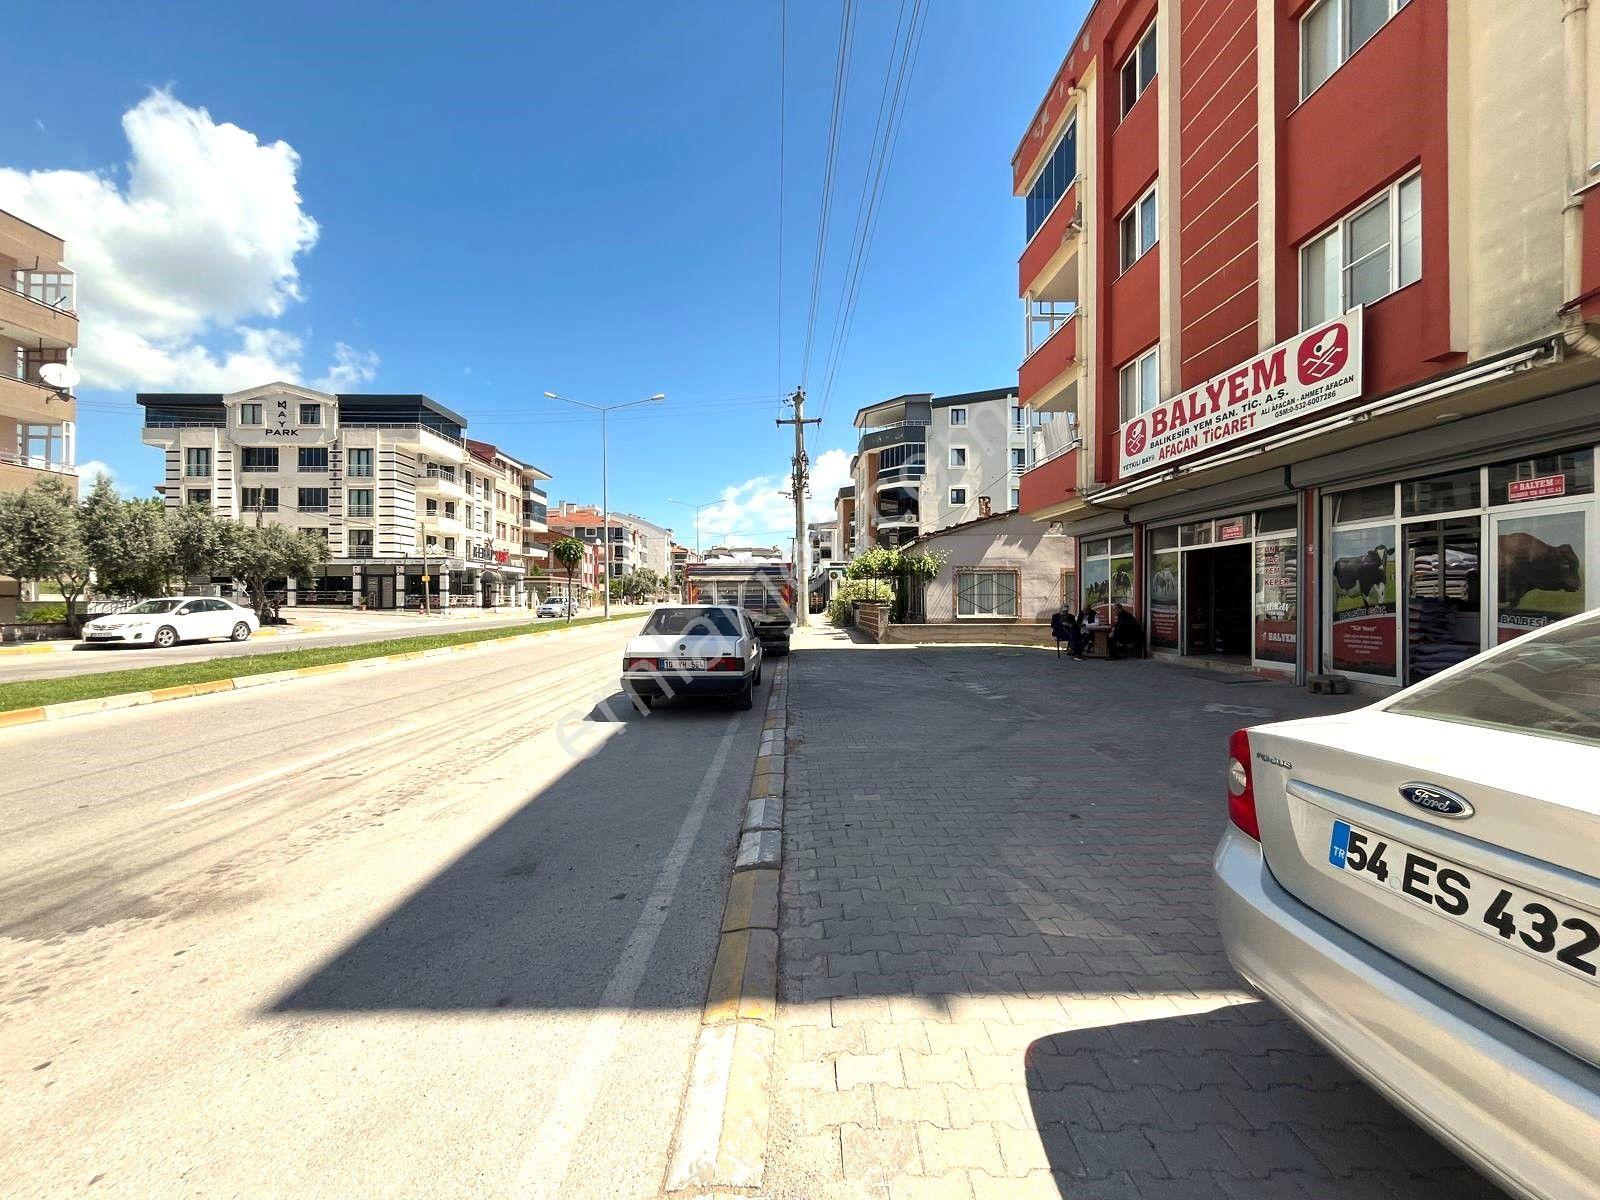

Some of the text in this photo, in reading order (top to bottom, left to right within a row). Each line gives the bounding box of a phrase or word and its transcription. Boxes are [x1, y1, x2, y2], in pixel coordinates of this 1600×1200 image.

[1151, 347, 1287, 438] BALYEM
[1271, 397, 1296, 412] AFACAN
[1300, 386, 1324, 401] AHMET
[1324, 375, 1354, 392] AFACAN
[265, 429, 299, 437] PARK
[1150, 388, 1289, 449] BALIKESİR YEM SAN. TİC. A.Ş.
[1158, 411, 1257, 461] AFACAN TİCARET
[1412, 789, 1451, 812] Ford
[1333, 831, 1600, 977] TR 54 ES 432
